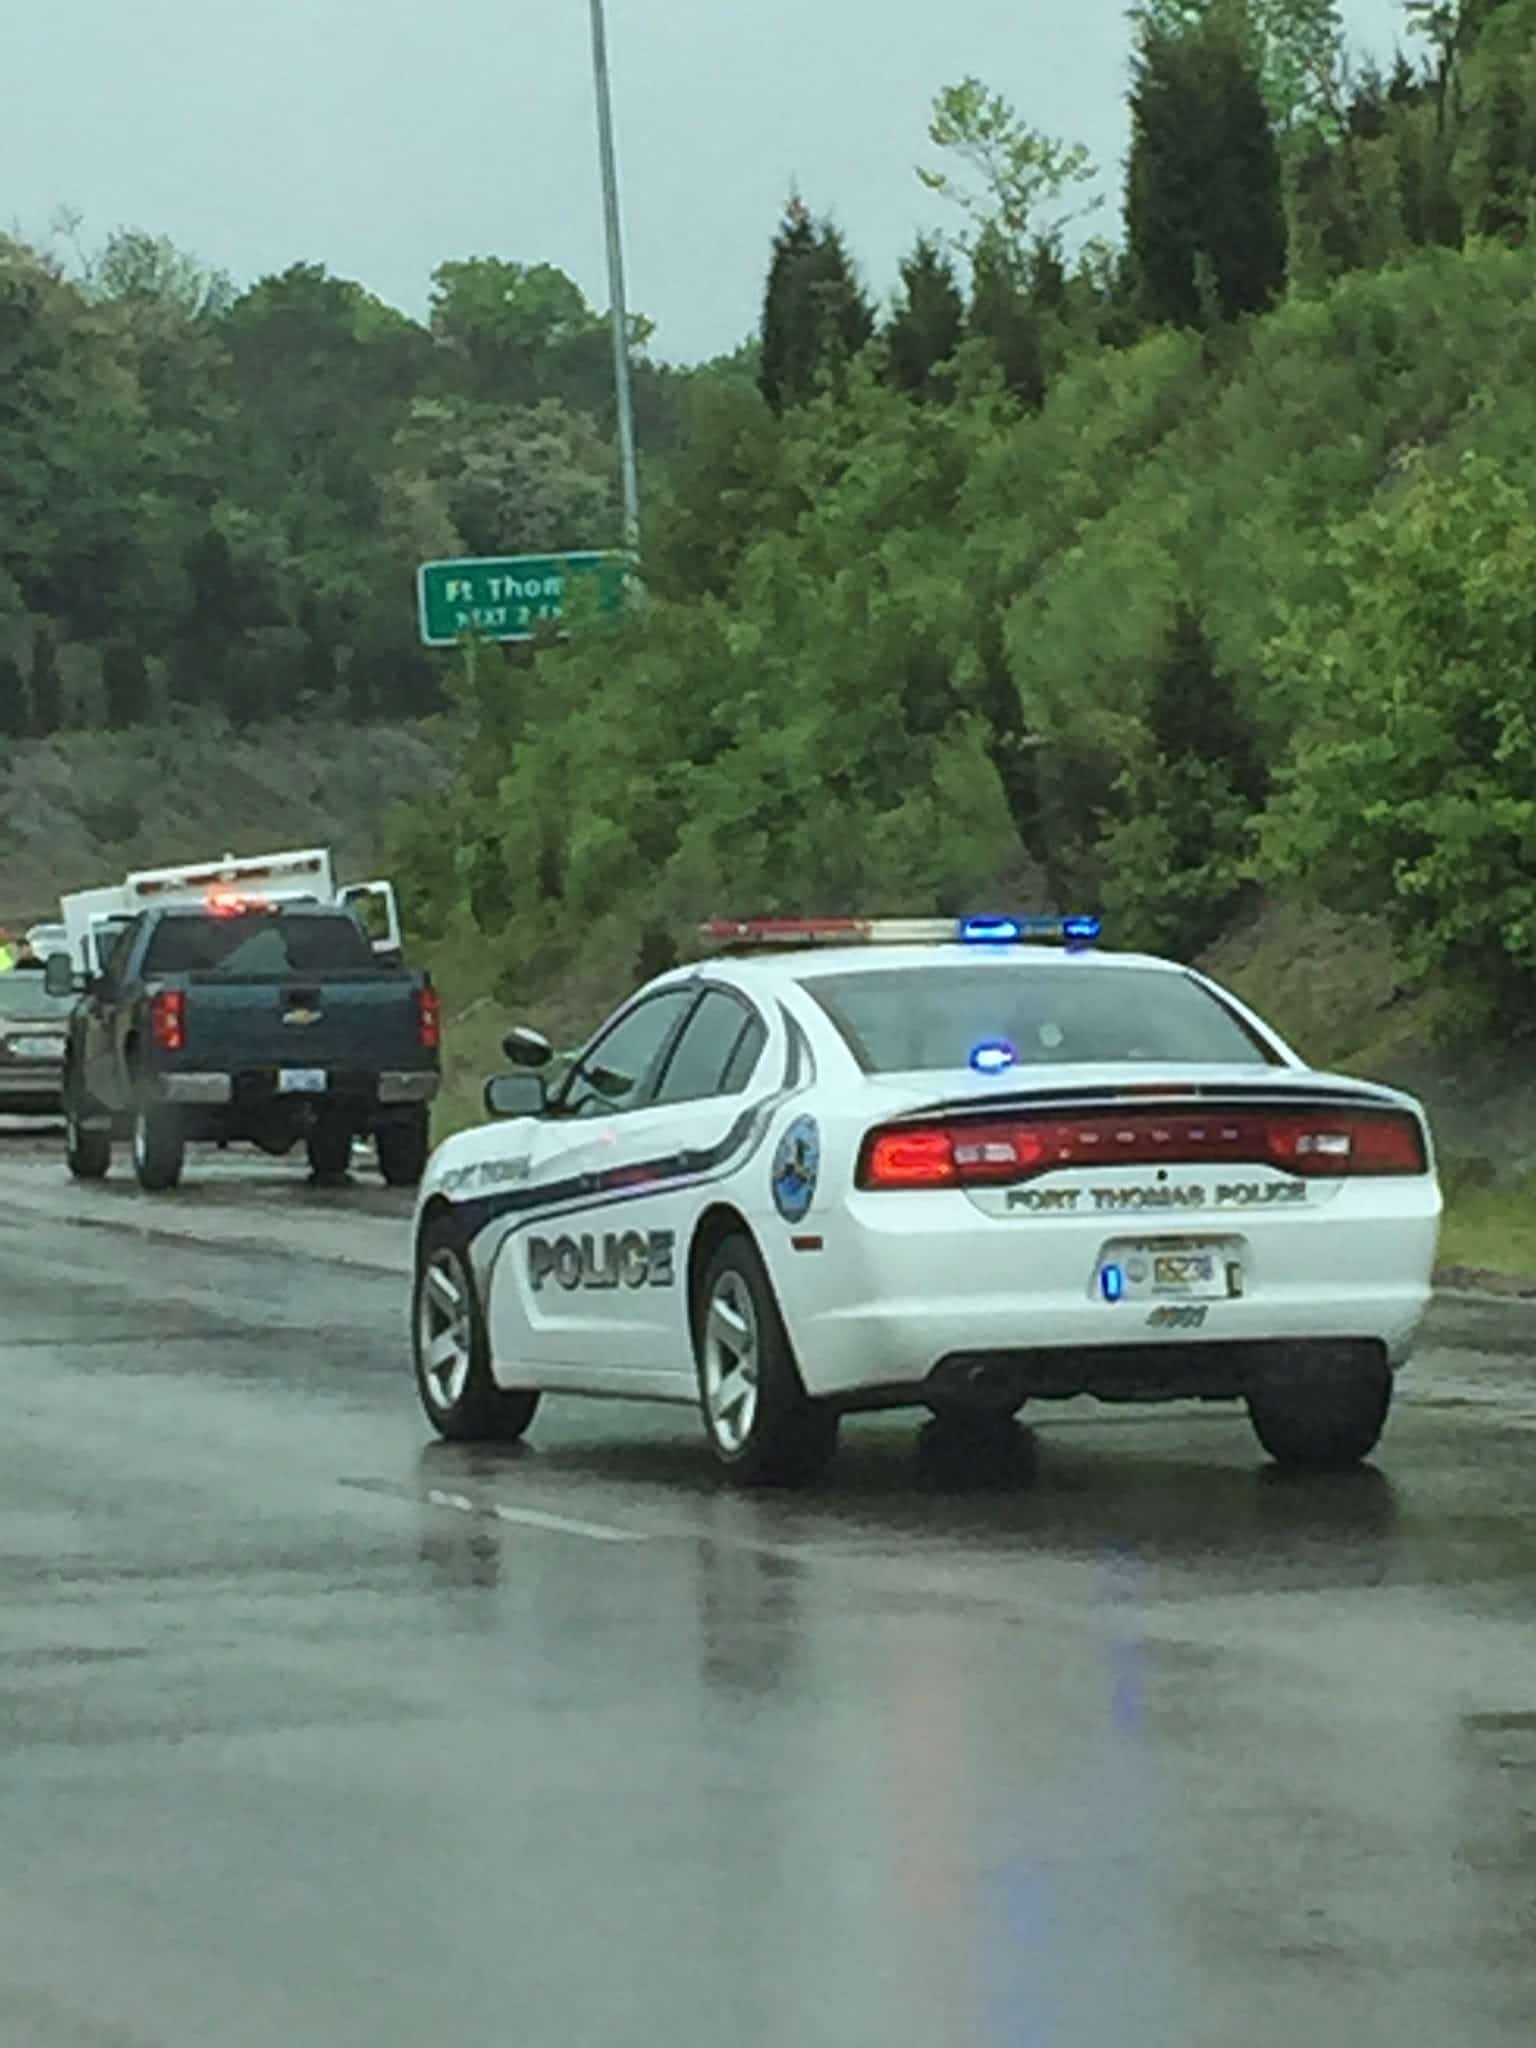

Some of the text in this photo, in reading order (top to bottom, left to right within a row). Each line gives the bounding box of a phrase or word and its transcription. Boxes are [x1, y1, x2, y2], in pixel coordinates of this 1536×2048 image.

[445, 579, 473, 602] Ft
[1005, 1181, 1307, 1210] FORT THOMAS POLICE
[527, 1229, 676, 1291] POLICE
